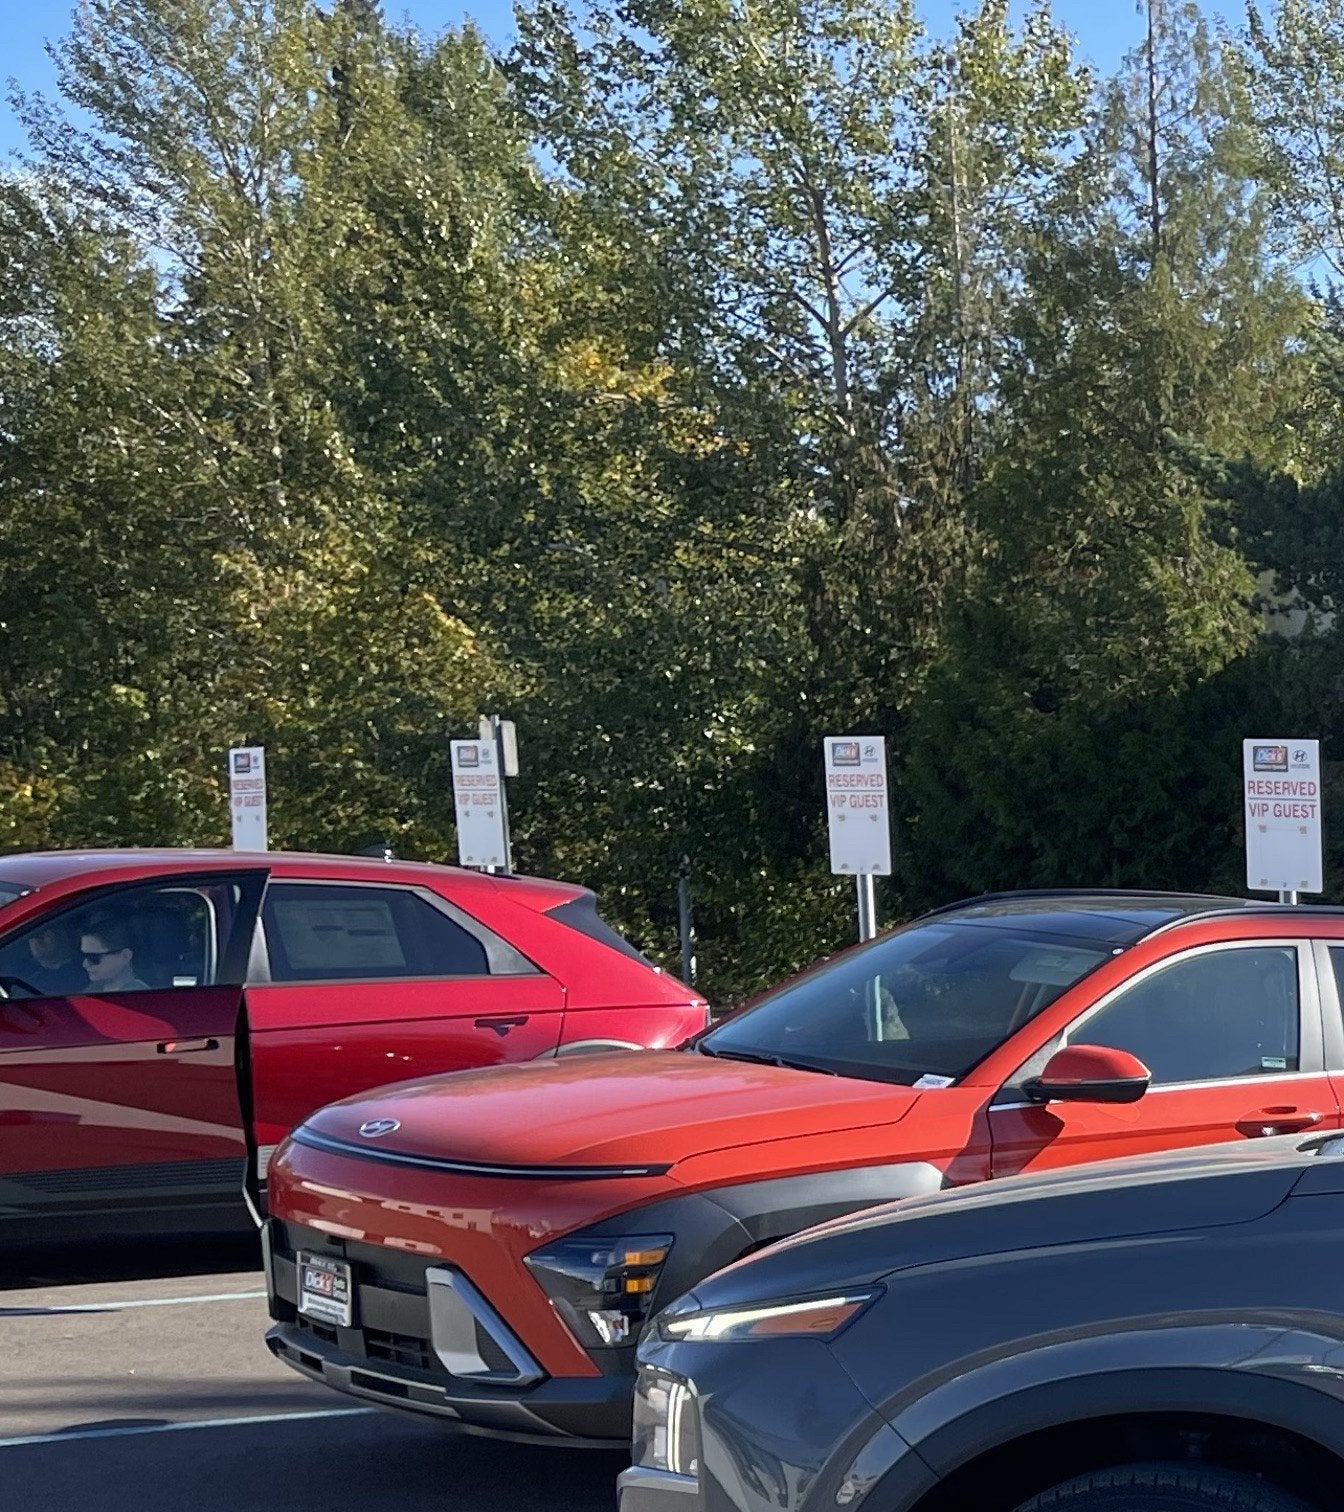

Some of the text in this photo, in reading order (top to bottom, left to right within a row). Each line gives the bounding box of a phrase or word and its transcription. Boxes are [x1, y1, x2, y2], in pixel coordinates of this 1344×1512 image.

[828, 774, 884, 788] RESERVED
[1248, 780, 1317, 796] RESERVED
[829, 794, 884, 809] VIP GUEST
[1248, 802, 1317, 819] VIP GUEST
